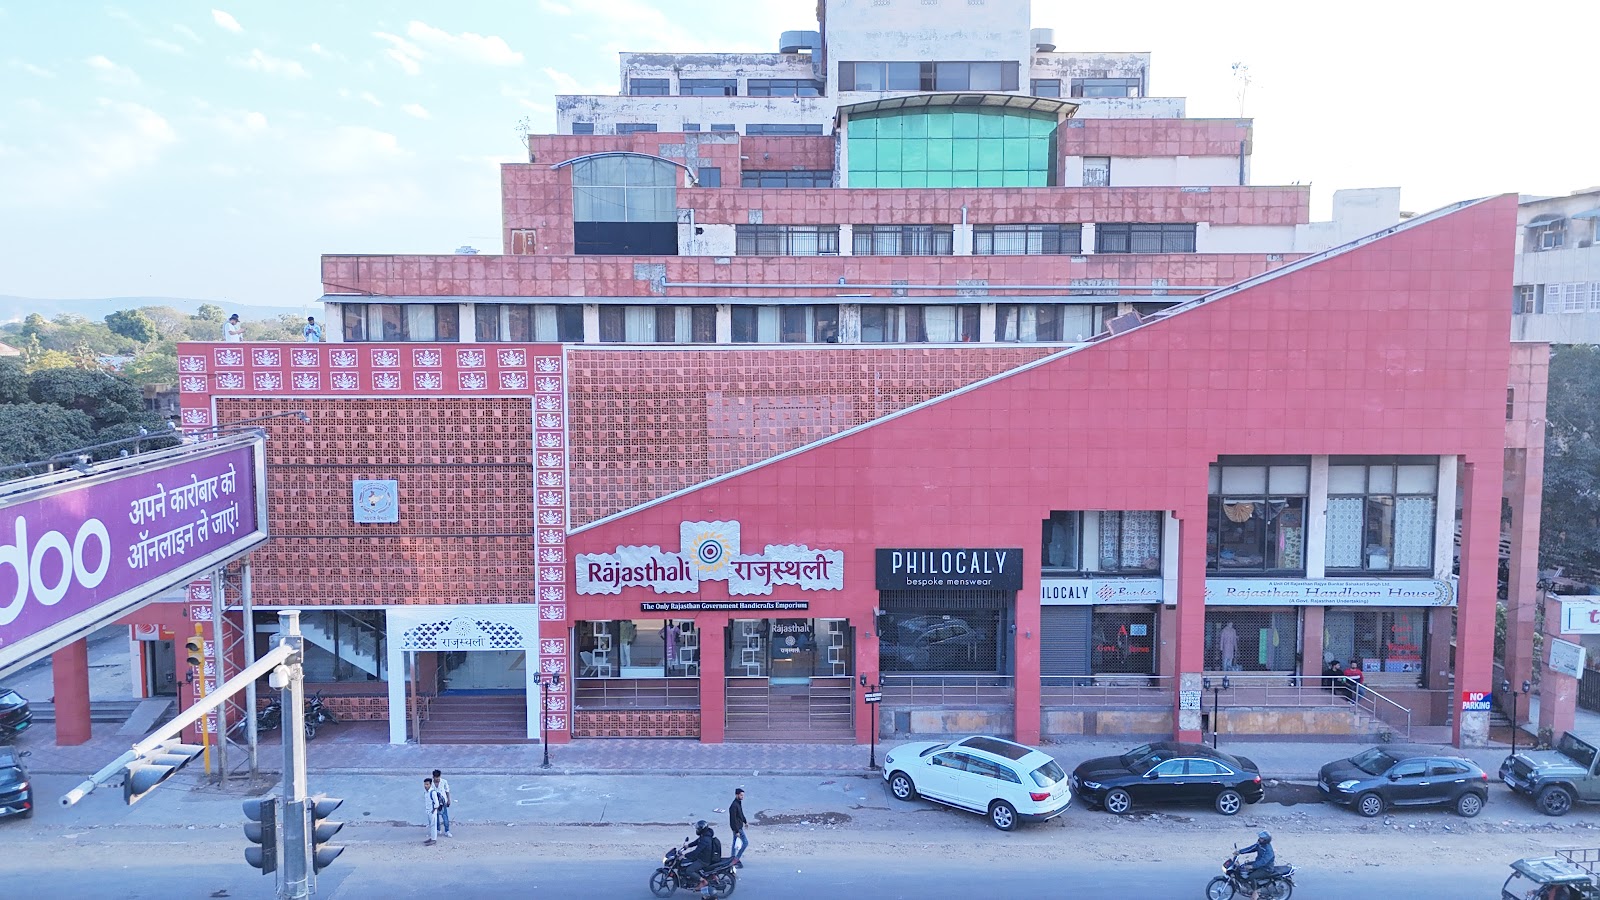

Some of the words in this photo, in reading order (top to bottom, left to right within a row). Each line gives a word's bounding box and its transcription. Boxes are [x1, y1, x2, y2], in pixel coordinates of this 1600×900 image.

[129, 483, 166, 527] अपने
[169, 474, 219, 513] कारोबार
[220, 463, 236, 494] को
[127, 529, 194, 569] ऑनलाइन
[197, 509, 208, 542] ले
[211, 501, 239, 535] जाएं!
[892, 551, 1007, 574] PHILOCALY
[730, 553, 834, 587] राजस्थली
[906, 577, 944, 587] bespoke
[946, 578, 992, 586] menswear
[1226, 587, 1299, 600] Rajasthan
[1305, 587, 1381, 598] Handloom
[1388, 587, 1435, 598] House
[655, 603, 669, 611] Only
[1469, 692, 1484, 701] NO
[1462, 701, 1490, 710] PARKING
